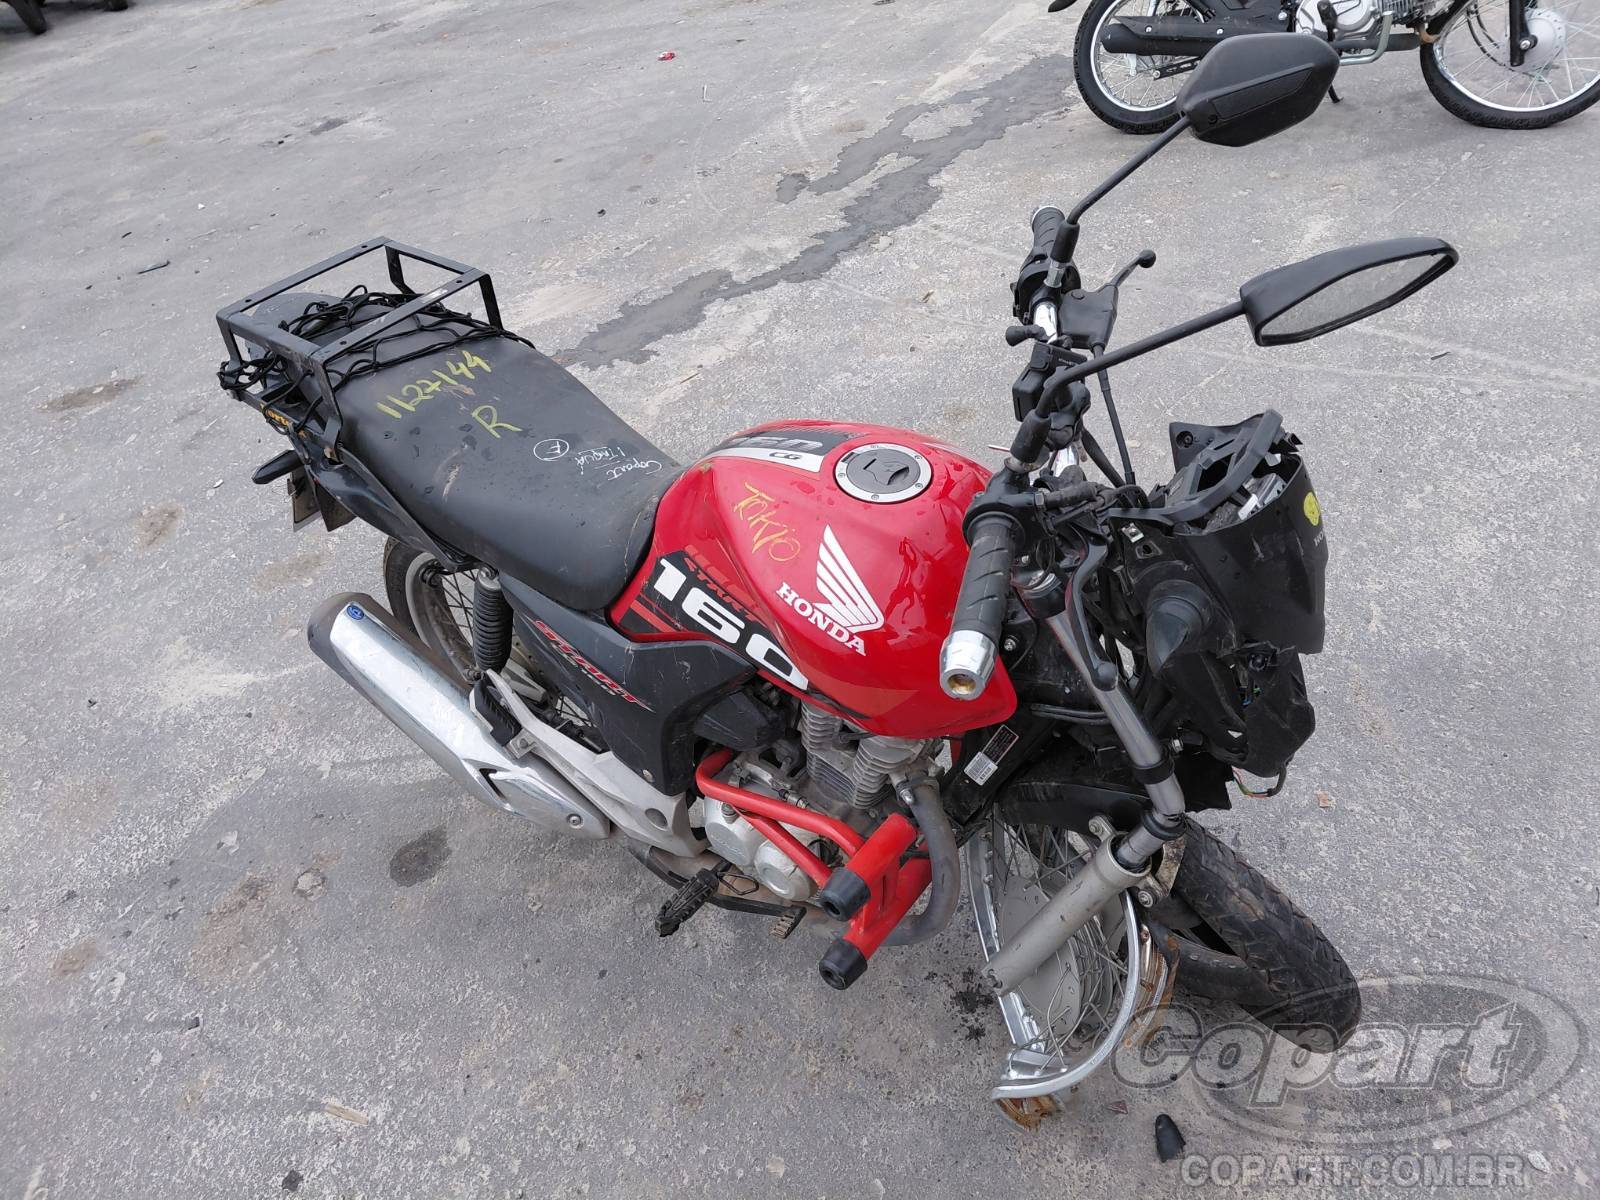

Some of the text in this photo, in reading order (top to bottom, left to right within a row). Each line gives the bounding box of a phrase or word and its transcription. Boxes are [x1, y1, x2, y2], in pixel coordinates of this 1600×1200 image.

[471, 404, 523, 439] R
[654, 558, 809, 691] 160
[776, 581, 867, 657] HONDA
